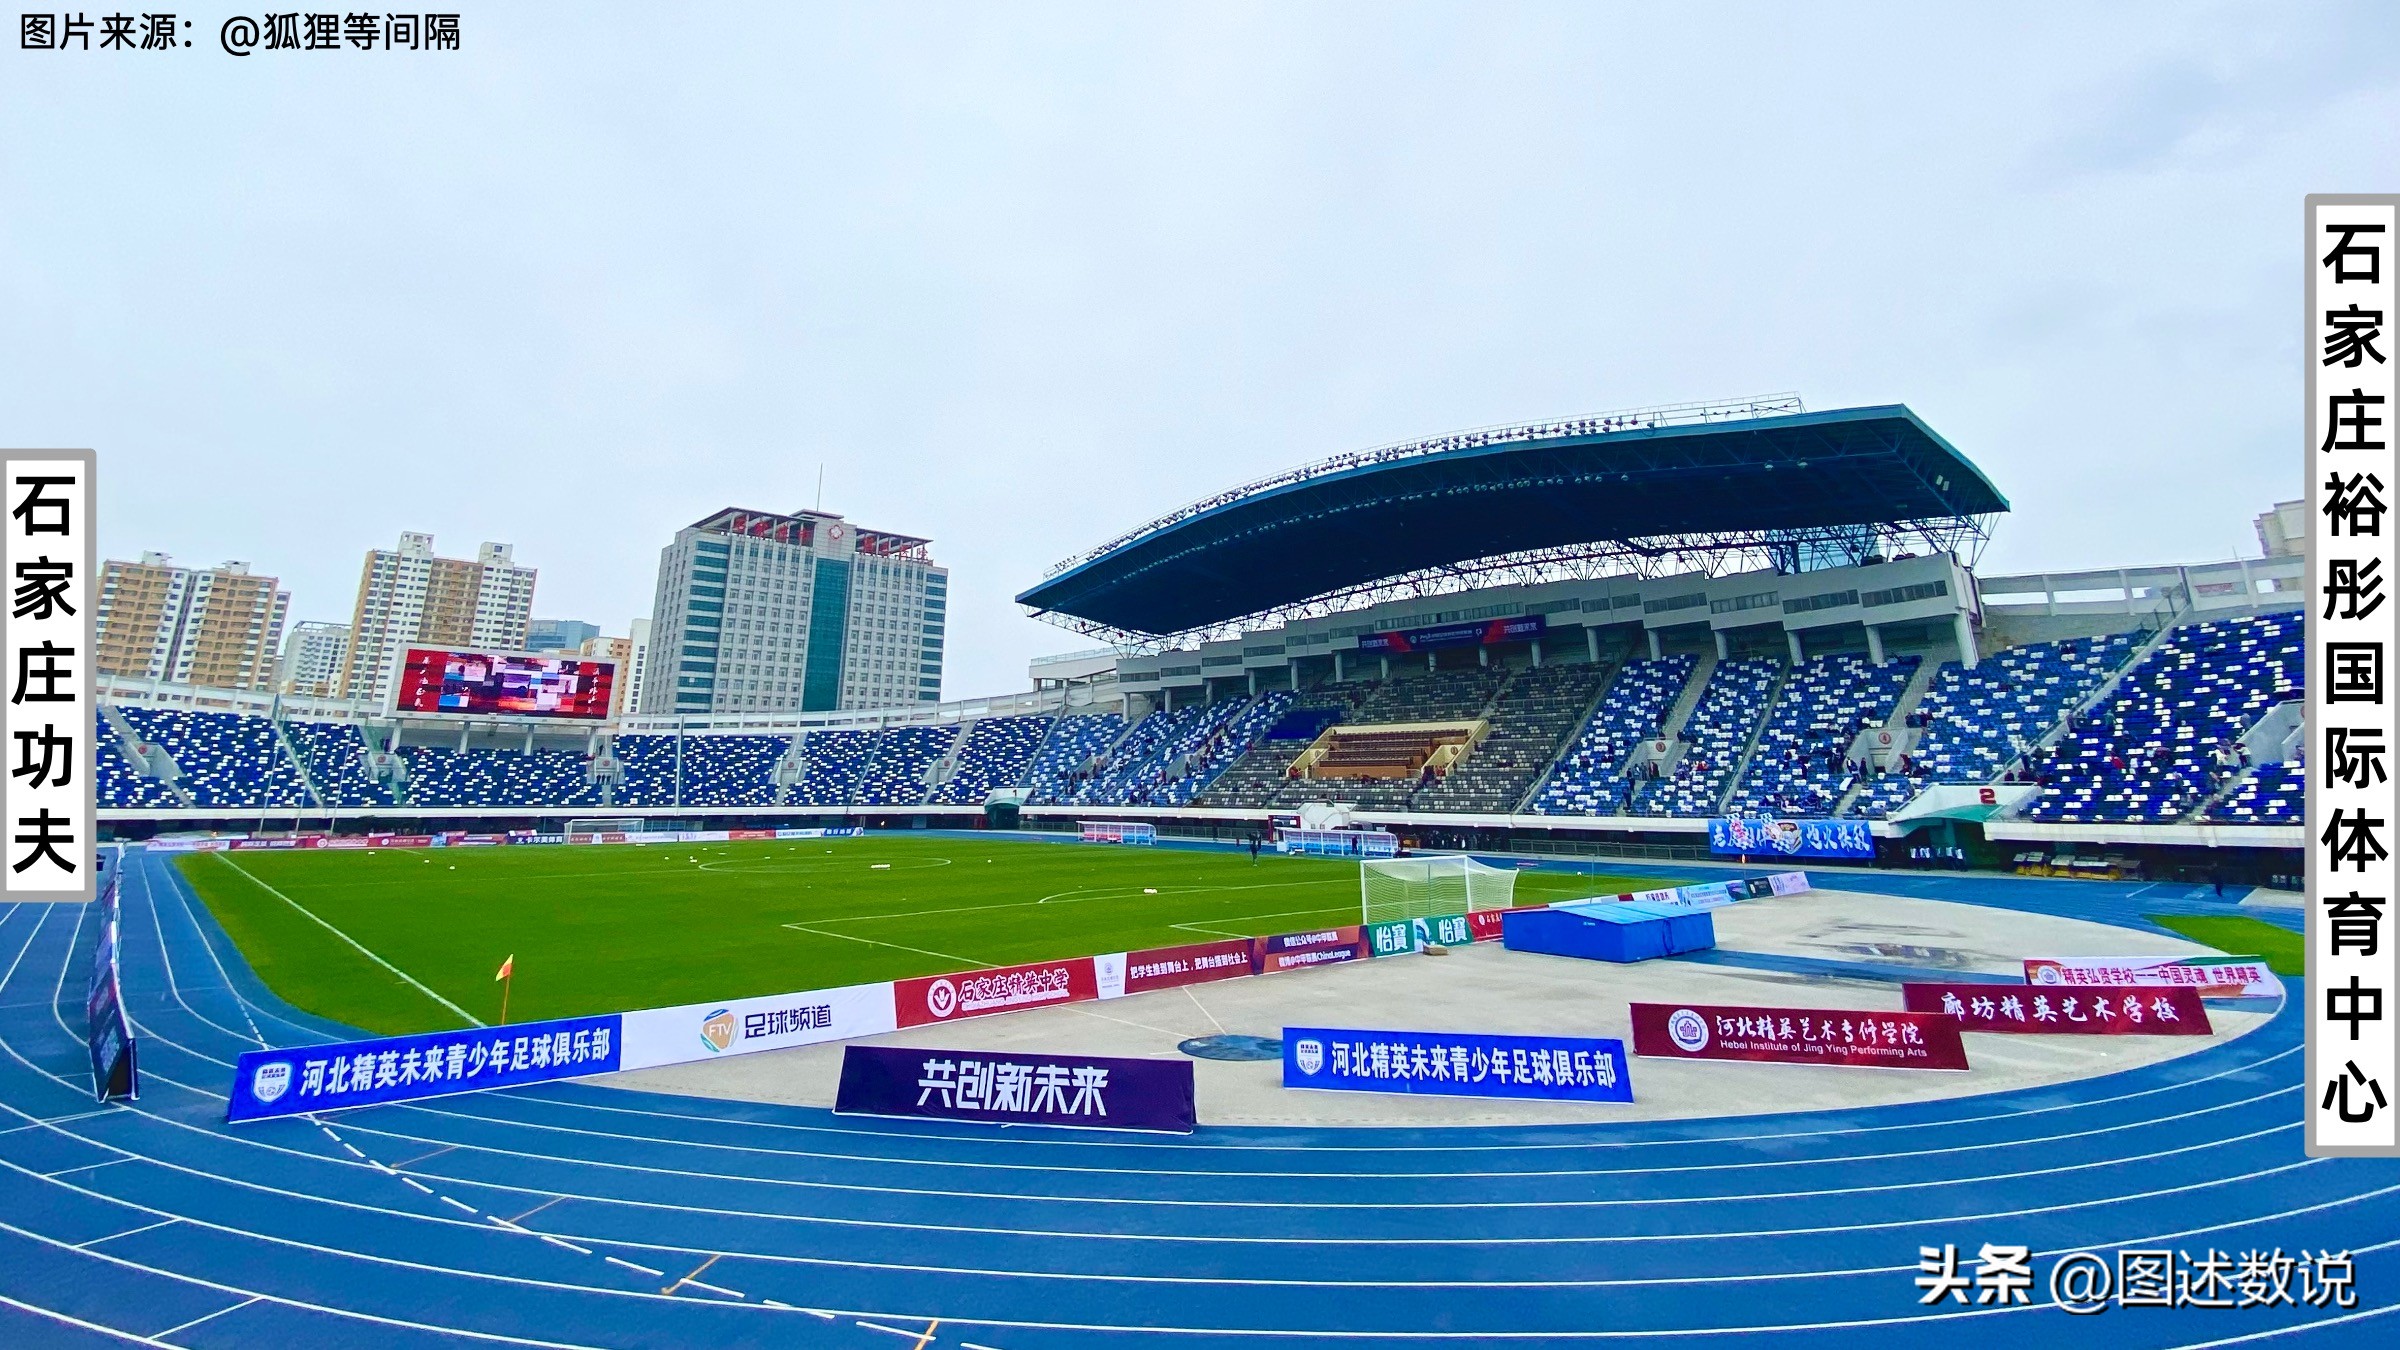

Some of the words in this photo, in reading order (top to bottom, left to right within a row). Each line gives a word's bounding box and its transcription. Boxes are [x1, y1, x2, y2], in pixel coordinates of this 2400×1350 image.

[1979, 788, 1997, 805] 2
[1376, 925, 1408, 952] 怡寶
[1438, 916, 1468, 943] 怡寶
[958, 968, 1069, 1003] 石家庄精英中学
[2212, 966, 2264, 984] 世界精英
[744, 1004, 832, 1039] 足球频道
[1941, 991, 2181, 1023] 廊坊精英艺术学校
[708, 1022, 732, 1038] FTV
[1716, 1014, 1925, 1045] 河北精英艺术专修学院
[299, 1027, 611, 1098] 河北精英未来青少年足球俱乐部
[1720, 1039, 1748, 1050] Hebei
[1750, 1041, 1788, 1052] Institute
[1791, 1042, 1801, 1052] of
[1803, 1043, 1824, 1055] Jing
[1825, 1044, 1849, 1056] Ying
[1850, 1046, 1904, 1058] Performing
[1907, 1047, 1927, 1057] Arts
[1331, 1040, 1617, 1089] 河北精英未来青少年足球俱乐部
[916, 1058, 1109, 1116] 共创新未来
